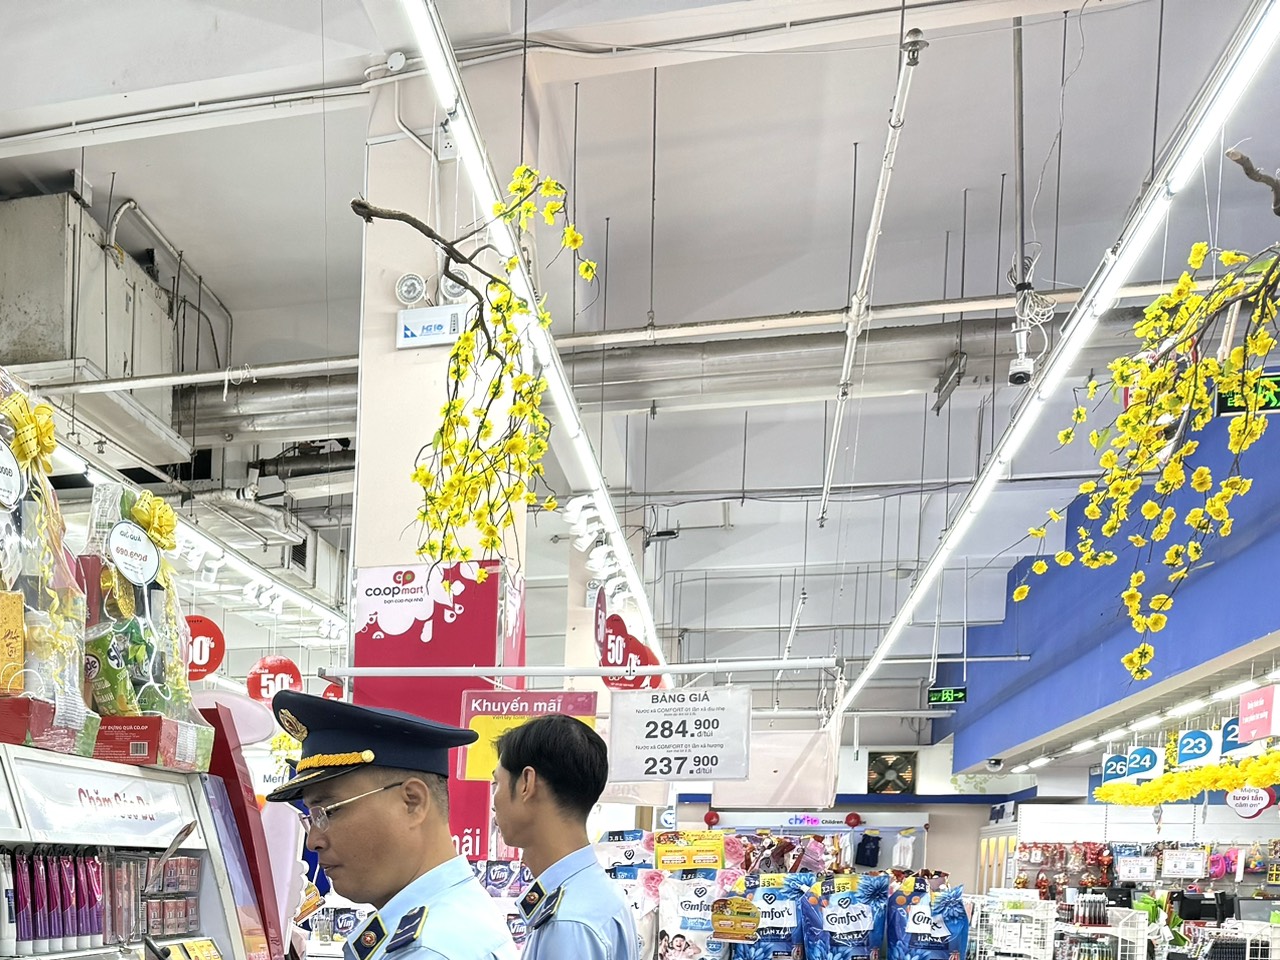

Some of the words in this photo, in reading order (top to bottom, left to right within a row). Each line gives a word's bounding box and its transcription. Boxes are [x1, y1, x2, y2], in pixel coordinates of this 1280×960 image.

[651, 692, 685, 704] BẢNG
[689, 691, 710, 702] GIÁ
[471, 697, 529, 714] Khuyến
[533, 698, 562, 712] mãi
[1181, 738, 1207, 754] 23
[1106, 761, 1126, 774] 26
[1129, 755, 1151, 768] 24
[826, 910, 867, 927] Comfort
